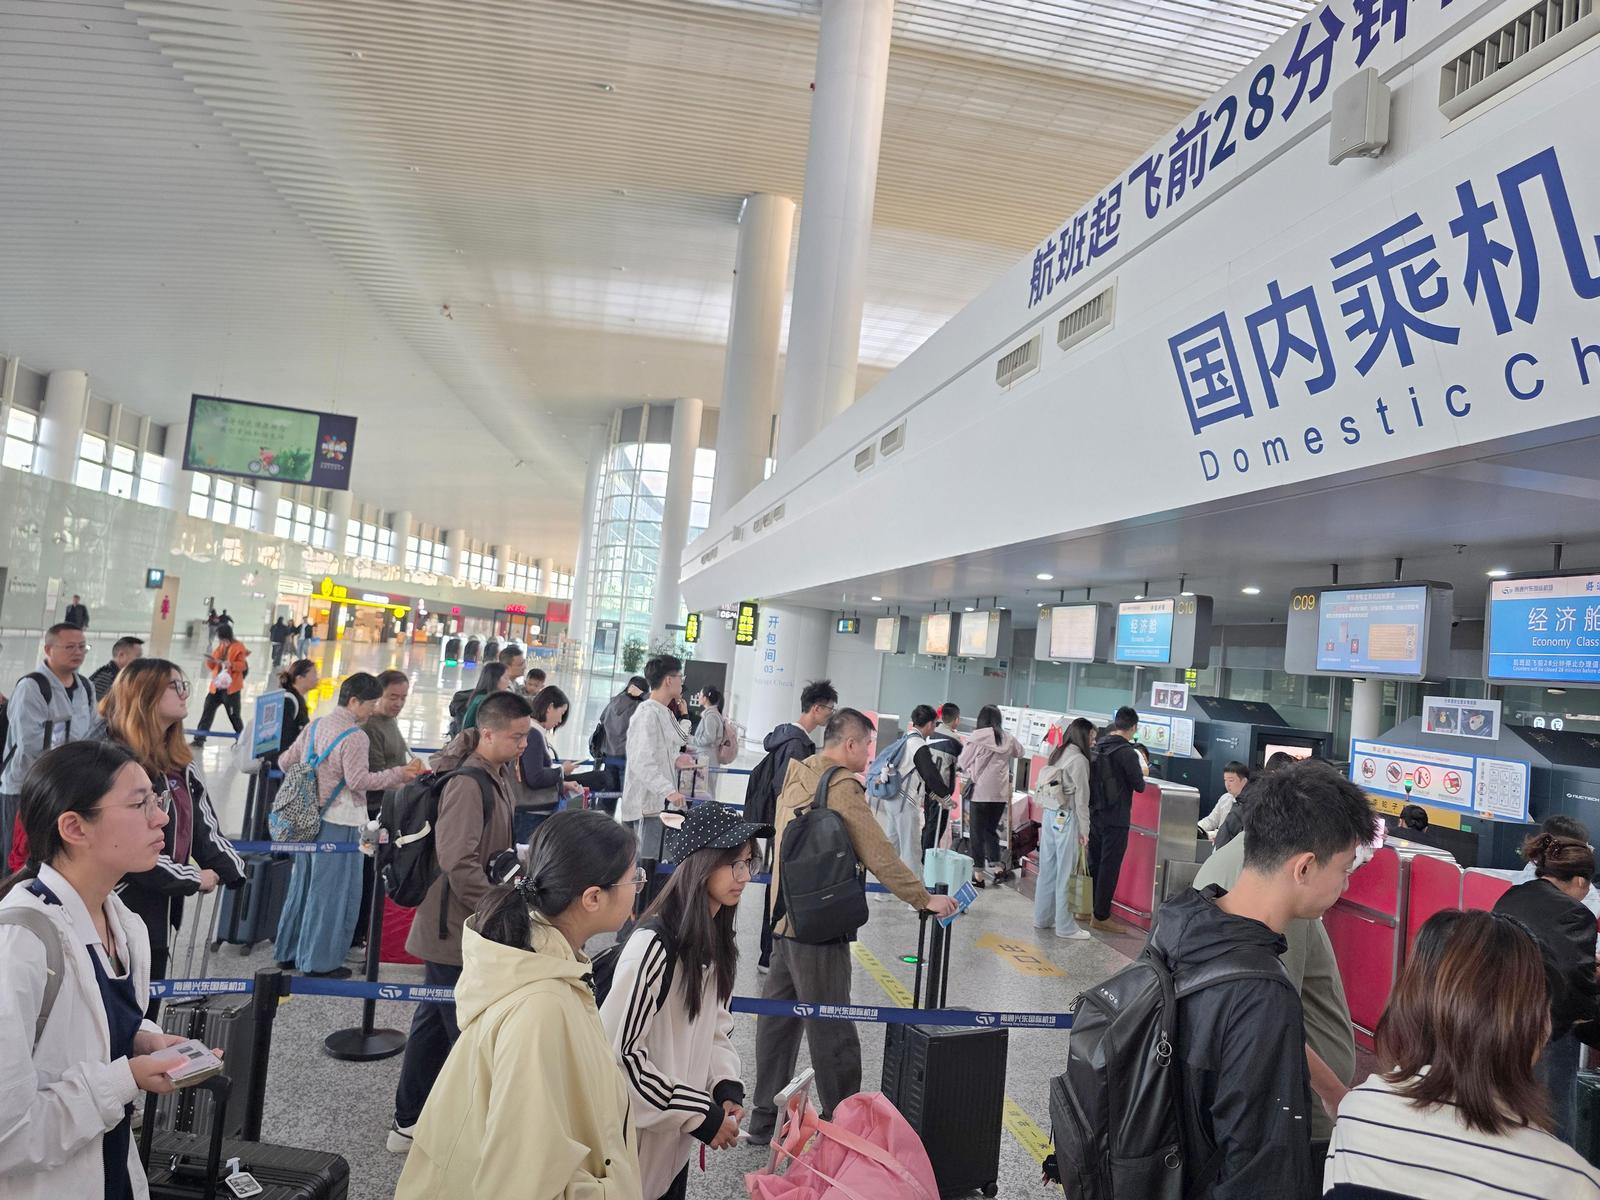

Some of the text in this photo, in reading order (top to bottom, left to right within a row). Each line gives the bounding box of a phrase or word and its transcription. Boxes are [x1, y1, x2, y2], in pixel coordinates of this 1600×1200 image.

[1028, 0, 1454, 309] 航班起飞前28分钟
[1168, 146, 1600, 436] 国内乘机
[1199, 337, 1600, 482] Domestic Ch
[1177, 601, 1194, 615] C10
[1293, 594, 1316, 611] C09
[1527, 606, 1600, 632] 经济舱
[764, 615, 780, 663] 开包间
[1532, 636, 1600, 648] Economy Class
[763, 665, 774, 673] 03
[173, 981, 246, 992] 南通兴东国际机场
[819, 1005, 878, 1017] 南通兴东国际机场
[1000, 1014, 1056, 1024] 南通兴东国际机场
